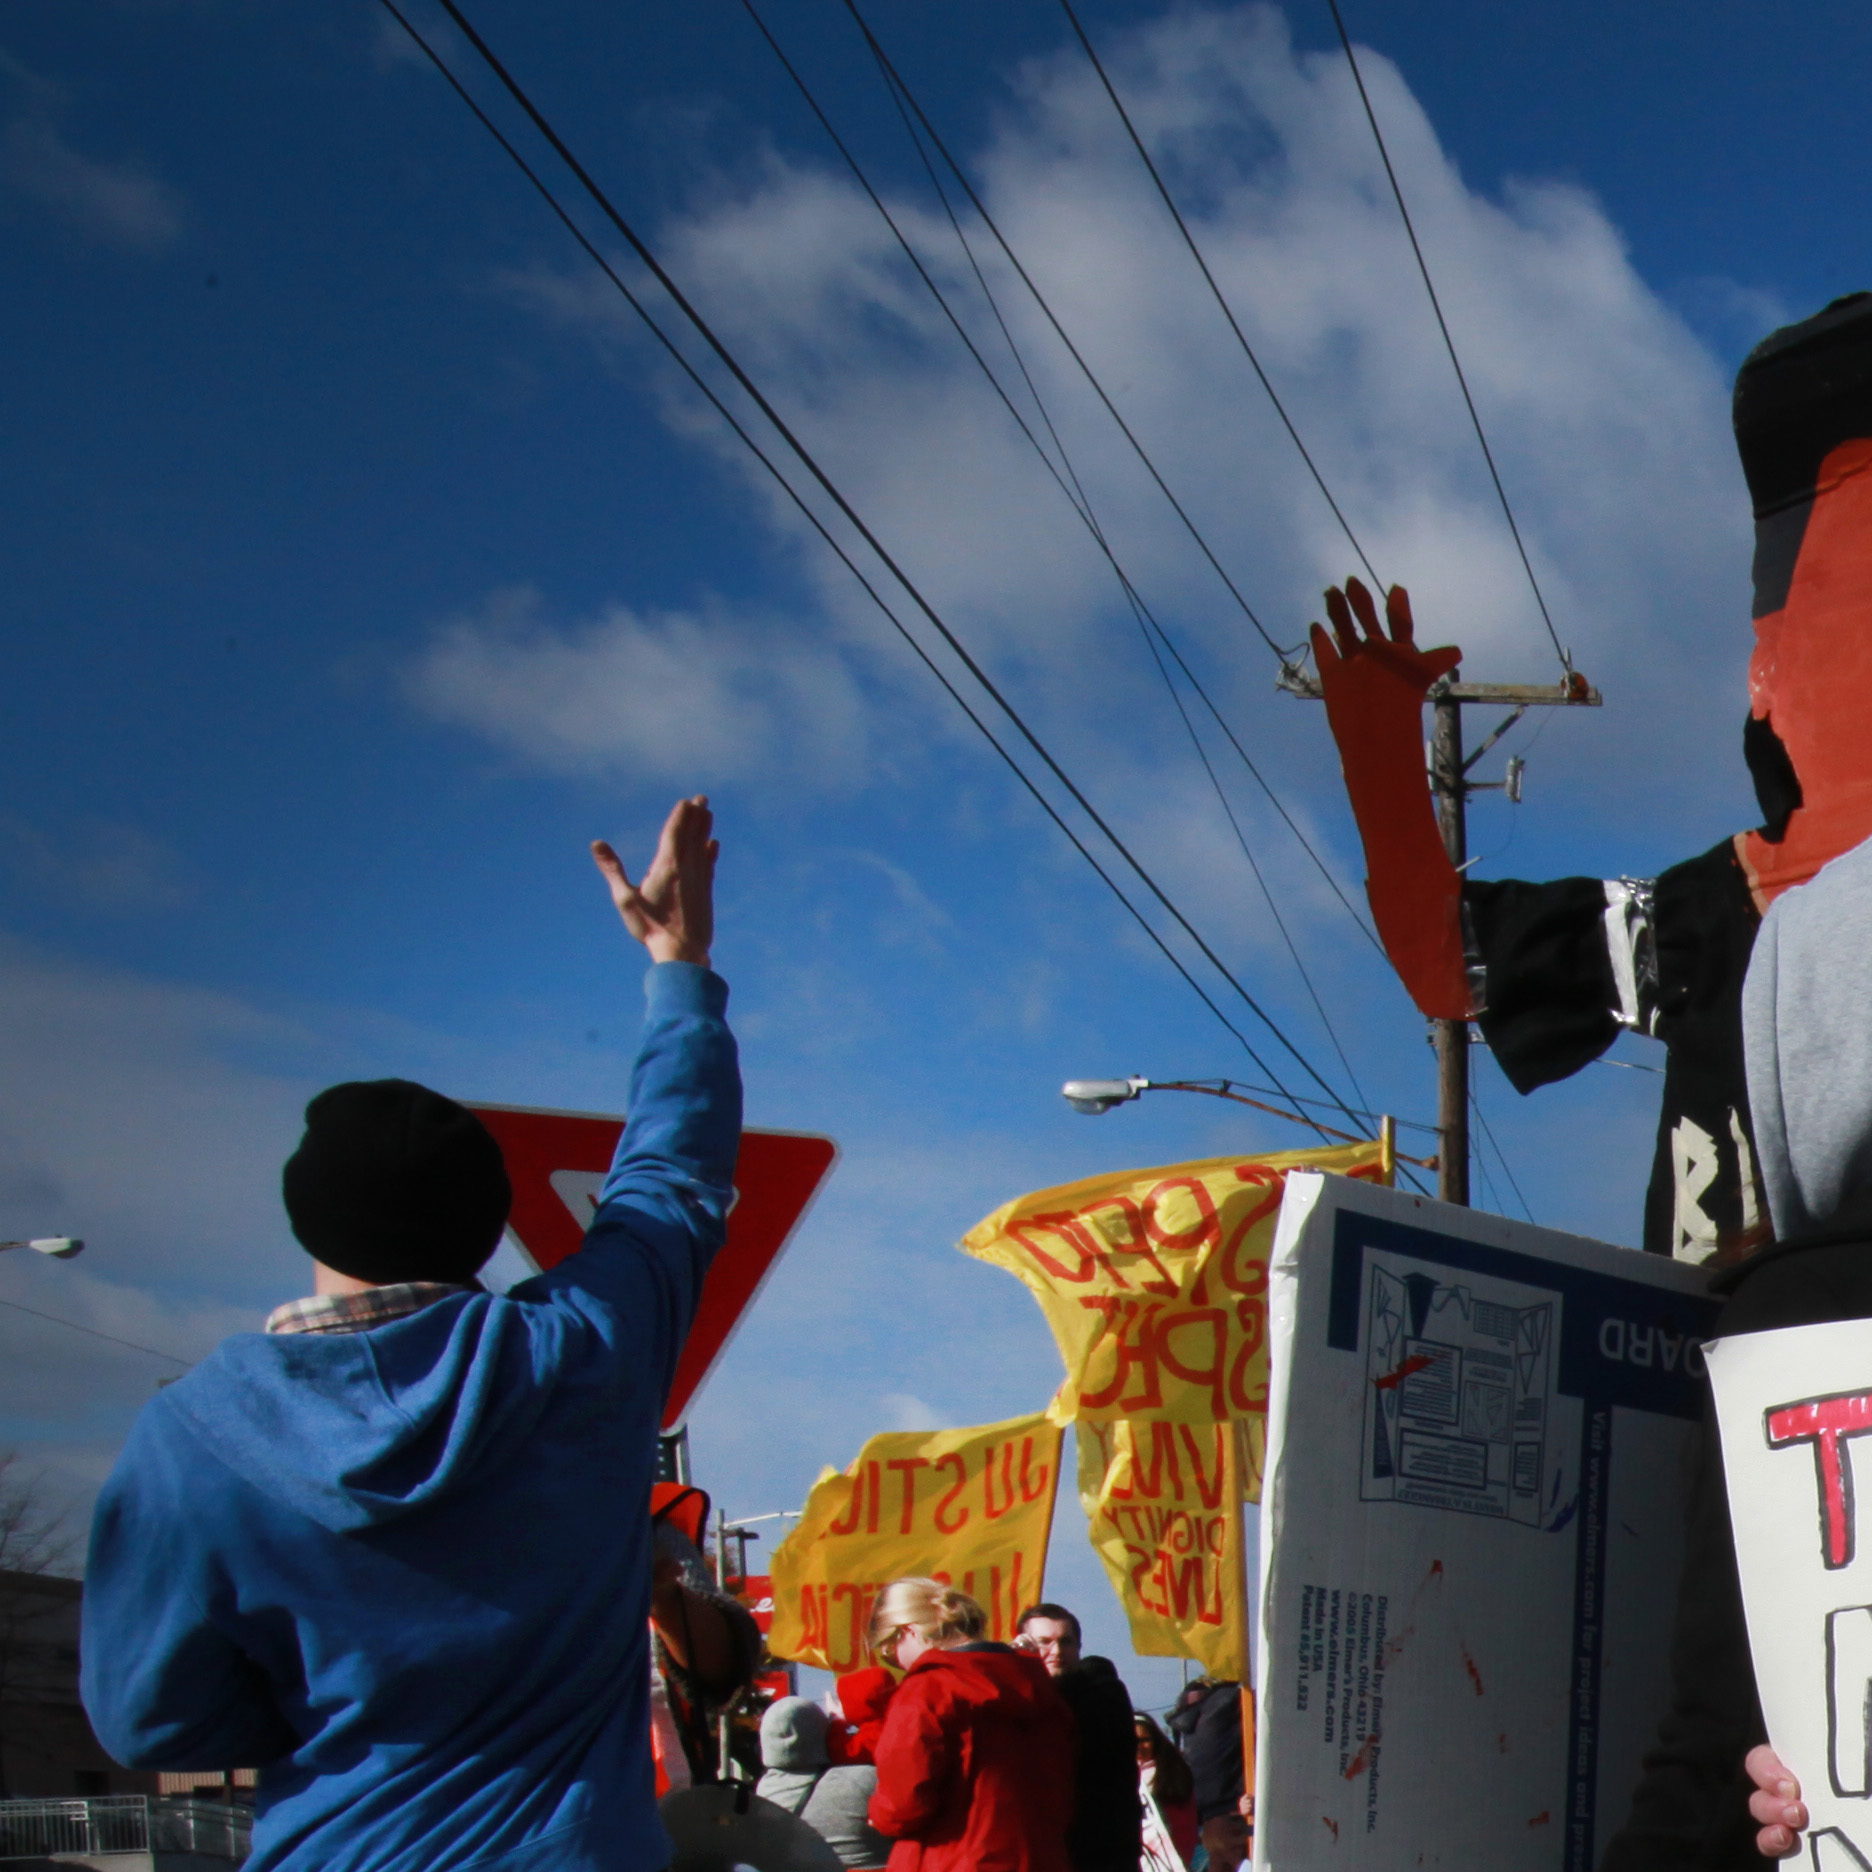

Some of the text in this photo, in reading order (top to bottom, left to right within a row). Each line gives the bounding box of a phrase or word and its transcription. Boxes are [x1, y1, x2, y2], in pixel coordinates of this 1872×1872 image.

[1598, 1318, 1707, 1379] OARD
[1583, 1457, 1602, 1618] www.elmers.com
[1301, 1585, 1314, 1630] Patent
[1315, 1587, 1328, 1625] Made
[1313, 1644, 1325, 1672] USA
[1325, 1590, 1342, 1743] www.elmers.com
